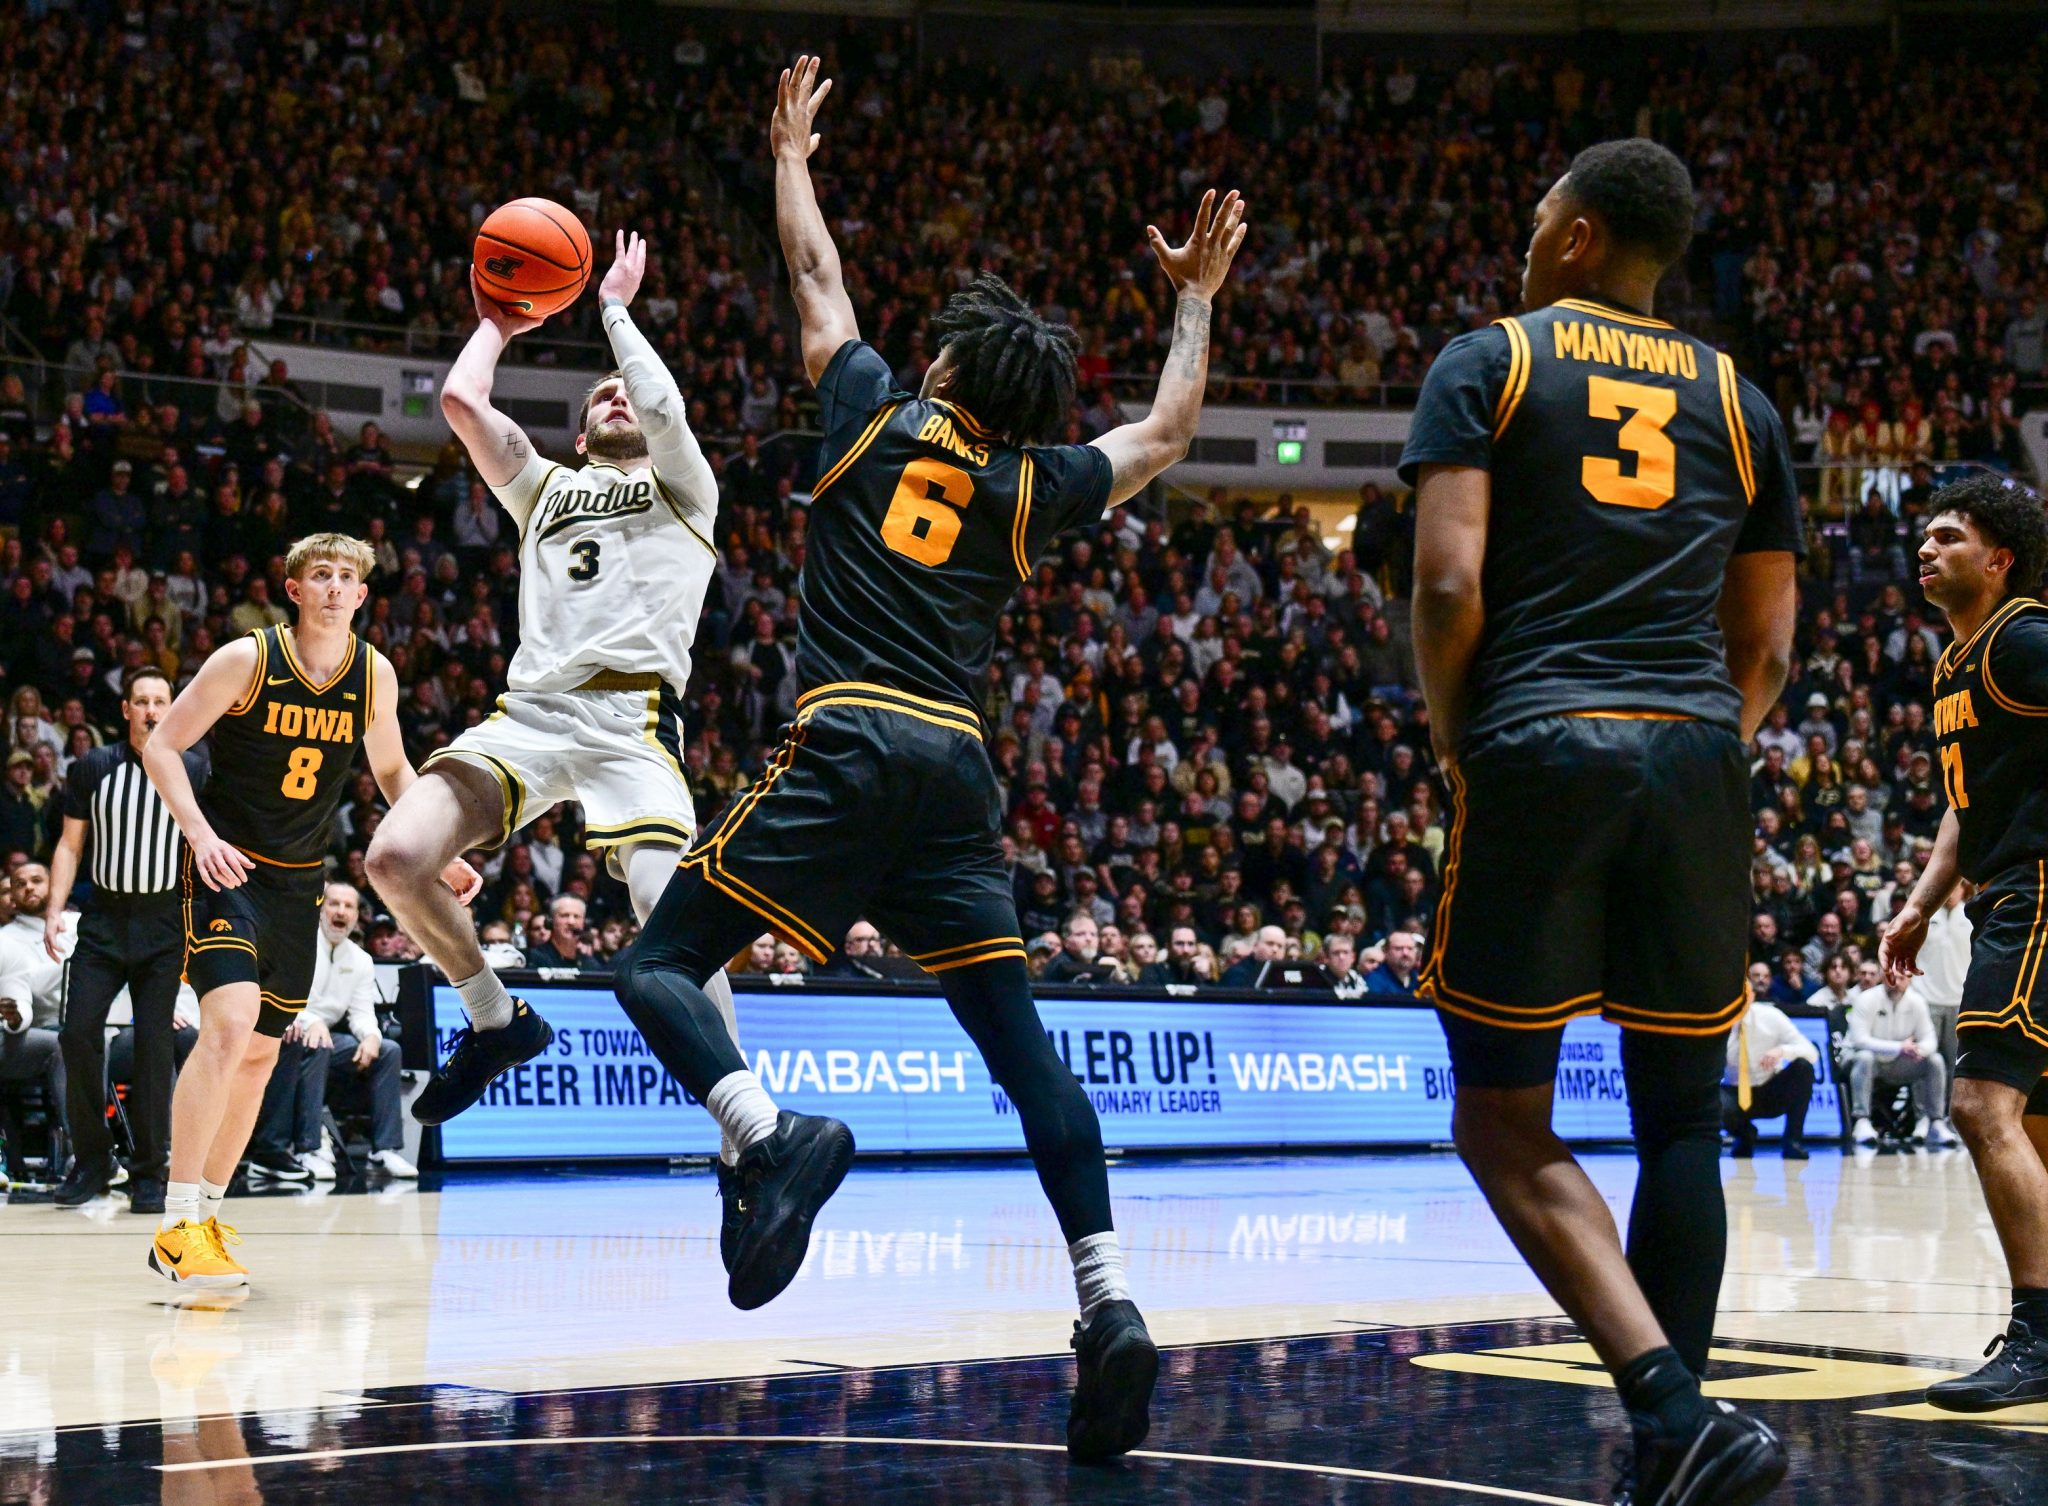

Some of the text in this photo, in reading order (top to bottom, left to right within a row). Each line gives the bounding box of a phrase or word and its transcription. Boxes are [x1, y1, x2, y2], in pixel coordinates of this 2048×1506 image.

[1553, 321, 1698, 380] MANYAWU
[918, 414, 989, 467] BANKS
[1581, 375, 1677, 510] 3
[535, 481, 653, 532] Purdue
[880, 457, 975, 568] 6
[568, 538, 601, 581] 3
[263, 701, 354, 744] IOWA
[1934, 689, 1979, 740] OWA
[281, 746, 324, 801] 8
[579, 1029, 652, 1056] TOWA
[1150, 1031, 1217, 1085] UP!
[479, 1064, 700, 1106] REER IMPA
[740, 1049, 966, 1093] WABASH
[1228, 1052, 1408, 1092] WABASH
[1558, 1067, 1625, 1100] IMPAC
[1159, 1090, 1222, 1113] LEADER
